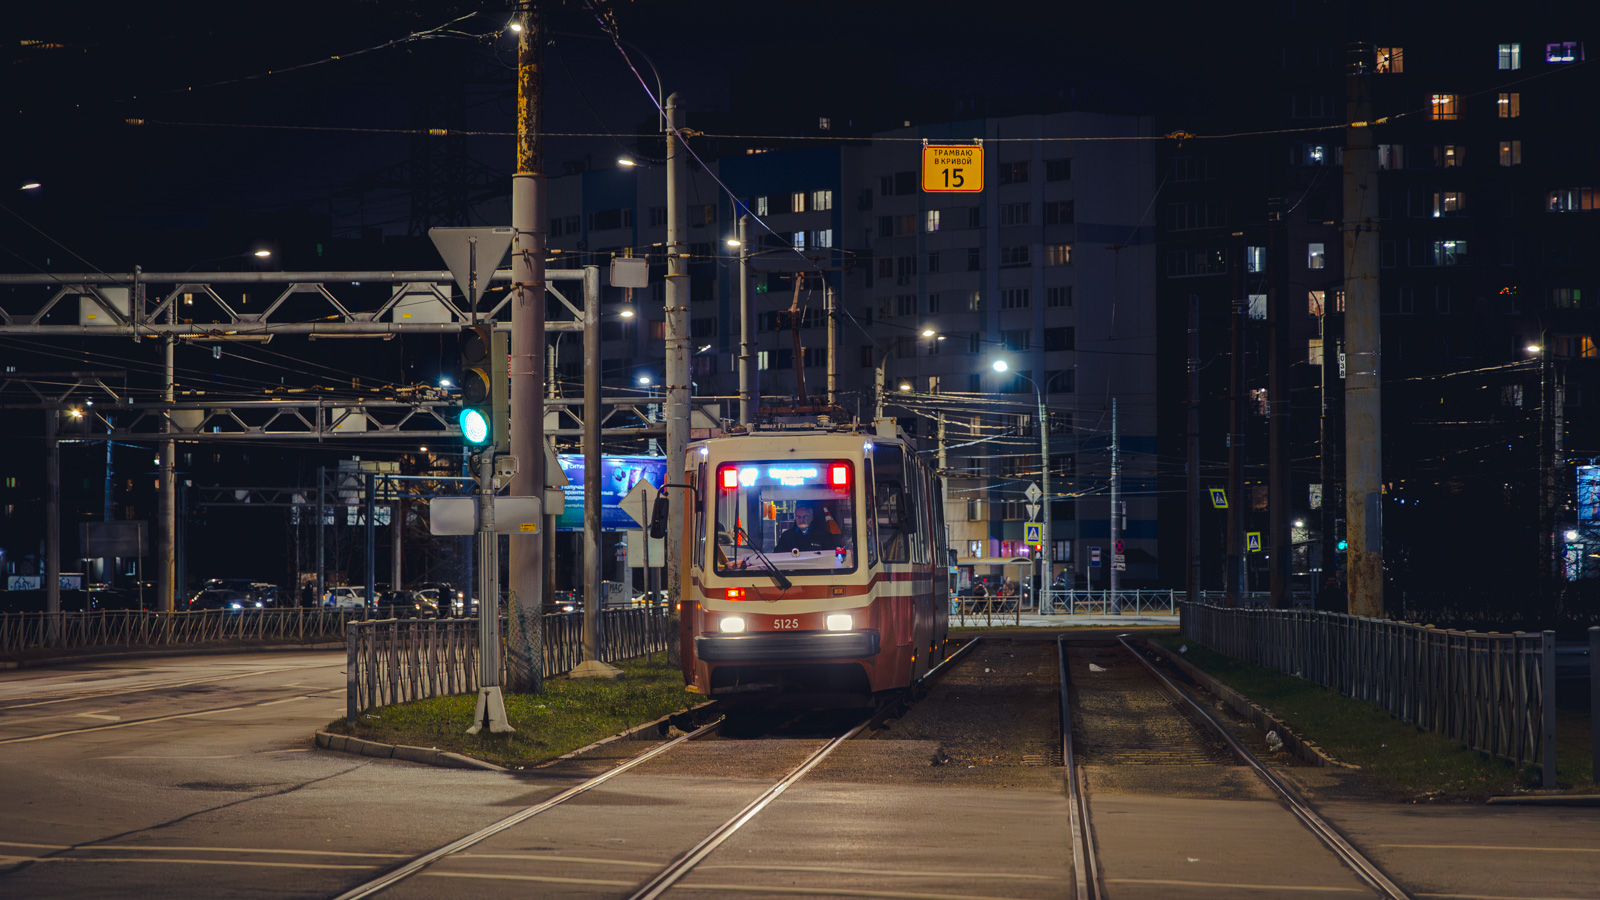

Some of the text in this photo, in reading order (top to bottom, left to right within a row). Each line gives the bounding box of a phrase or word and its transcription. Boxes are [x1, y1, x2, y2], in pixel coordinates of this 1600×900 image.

[941, 157, 972, 165] КРИВОЙ
[942, 168, 964, 187] 15
[774, 618, 799, 629] 5125
